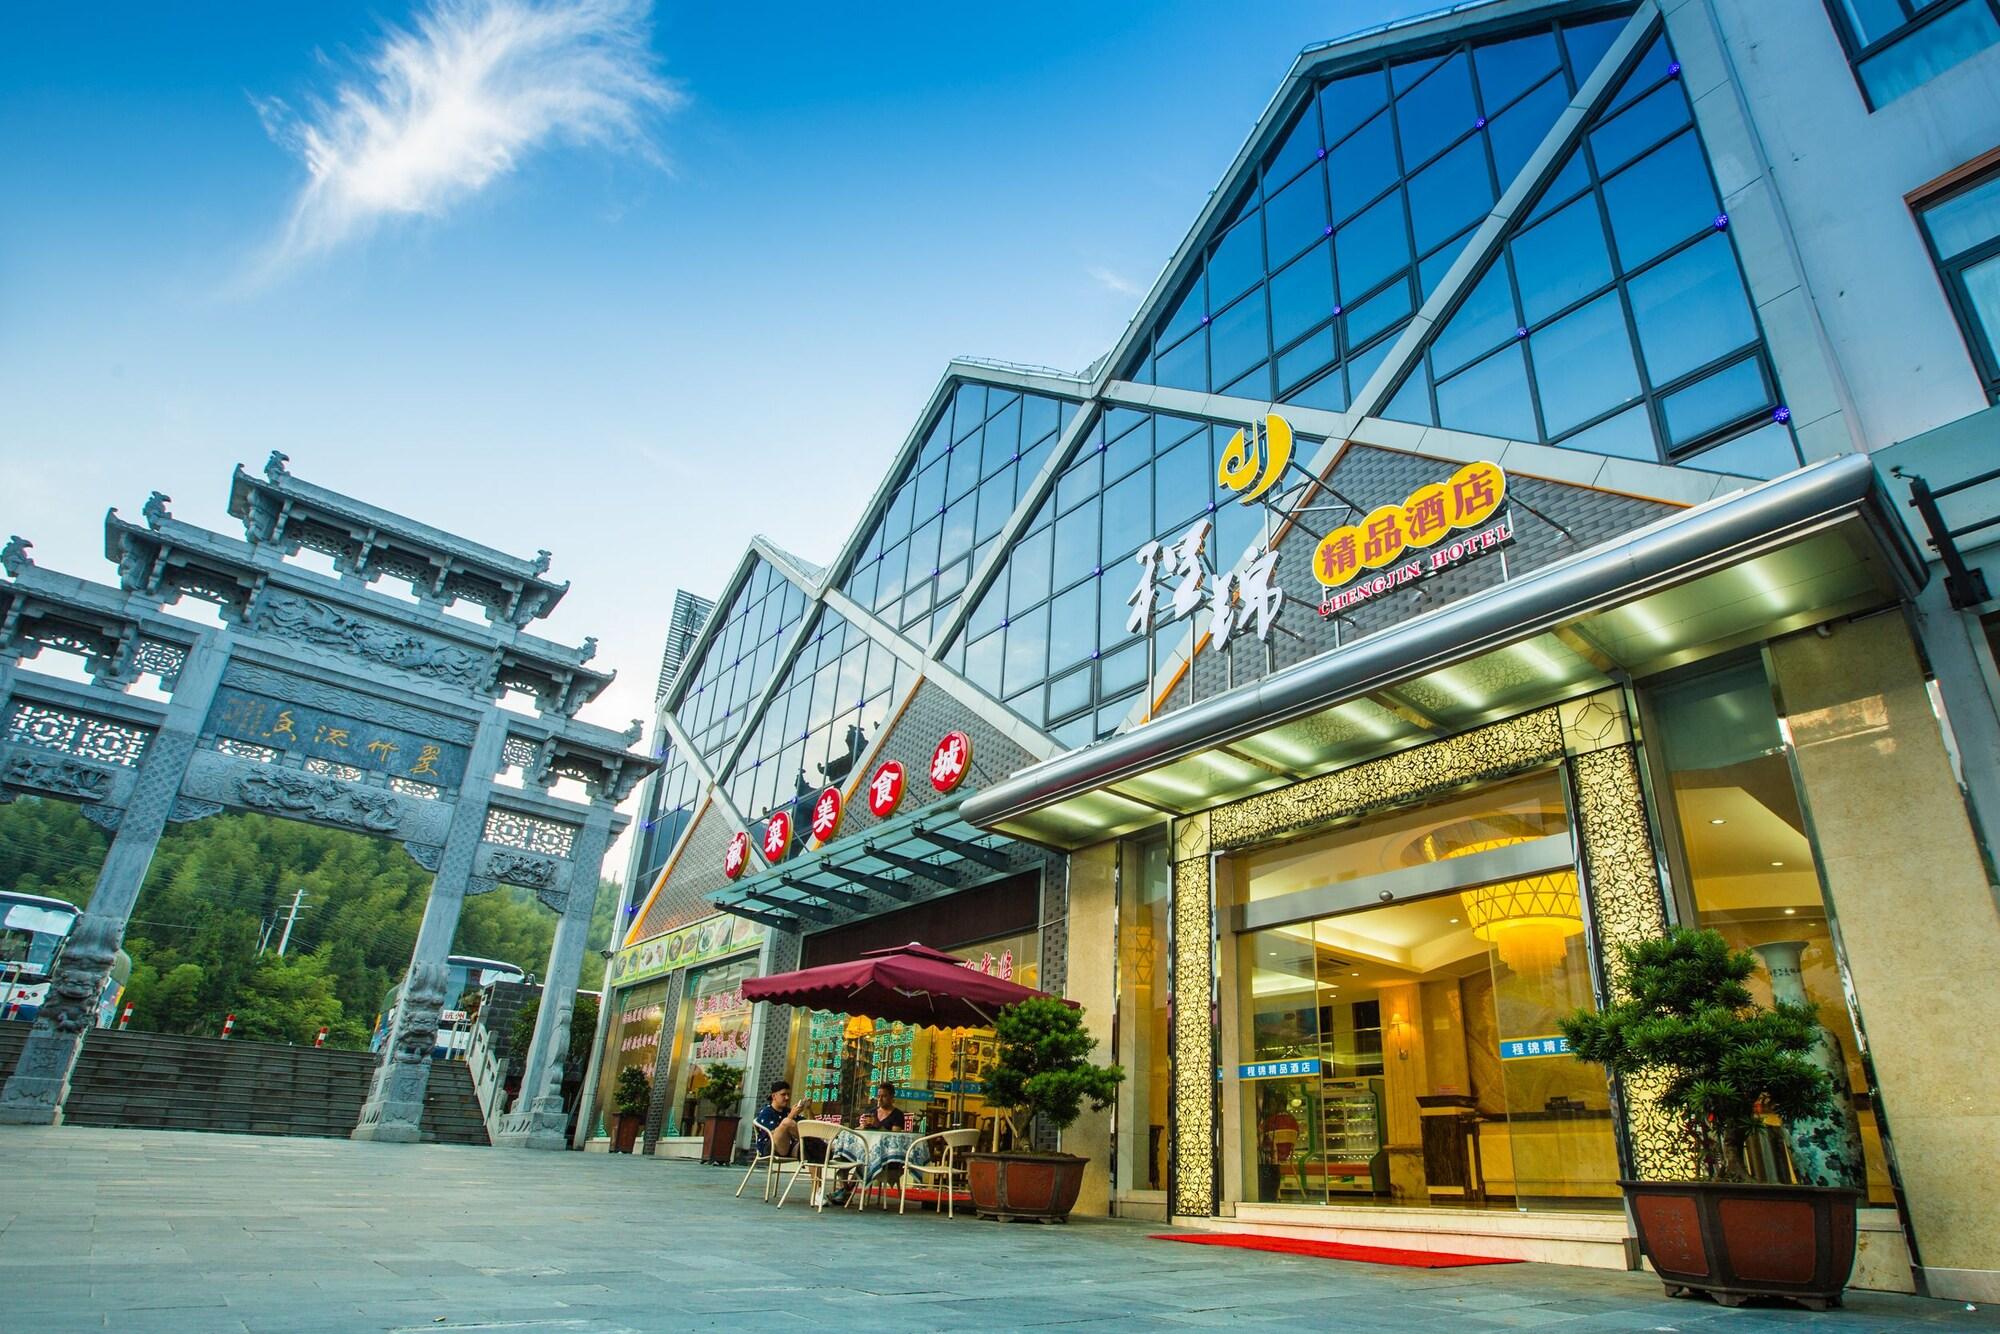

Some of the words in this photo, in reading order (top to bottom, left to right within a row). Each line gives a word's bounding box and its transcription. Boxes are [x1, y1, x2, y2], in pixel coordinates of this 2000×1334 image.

[1317, 561, 1421, 617] CHENGJIN
[1430, 523, 1512, 570] HOTEL
[1321, 468, 1495, 580] 精品酒店
[725, 739, 962, 873] 徽菜美食城
[1247, 1062, 1311, 1077] 程锦精品酒店
